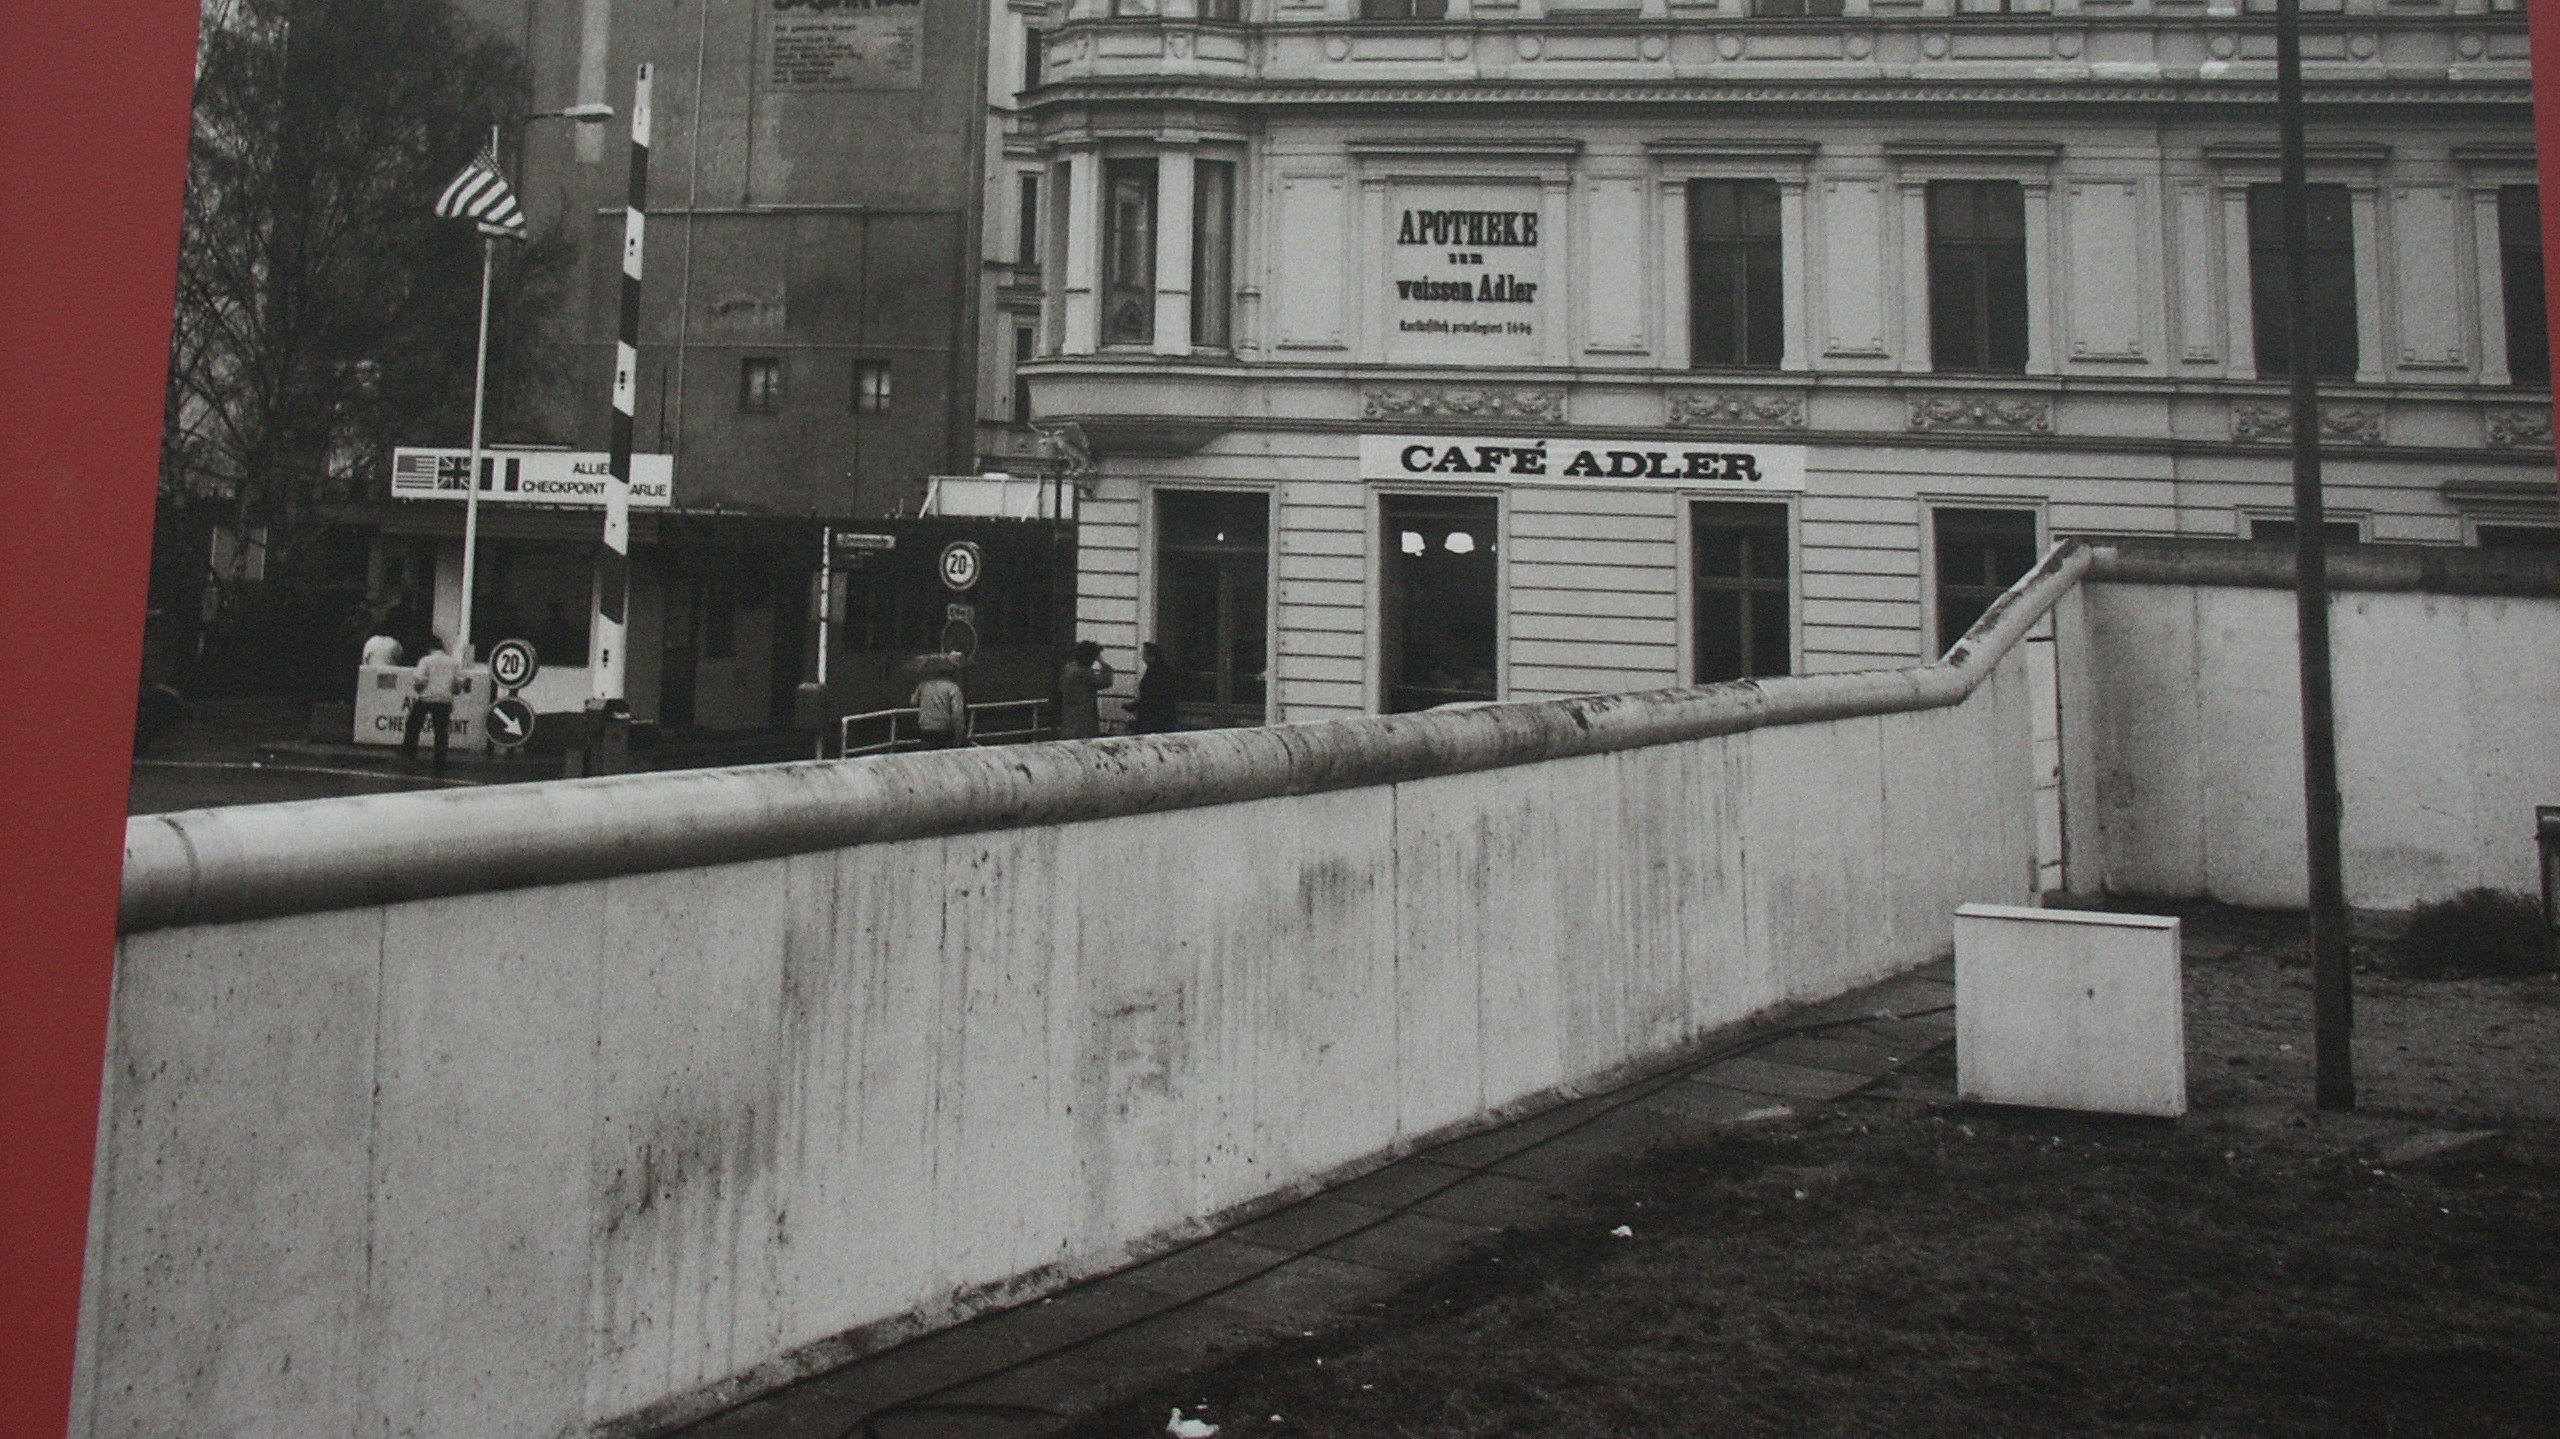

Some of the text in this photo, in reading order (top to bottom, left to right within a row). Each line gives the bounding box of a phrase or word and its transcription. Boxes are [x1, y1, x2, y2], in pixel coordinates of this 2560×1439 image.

[1397, 209, 1539, 247] APOTHEKE
[1396, 273, 1538, 303] weissen Adler
[573, 462, 609, 475] ALLIE
[1400, 440, 1762, 482] CAFÉ ADLER
[522, 480, 606, 495] CHECKPOINT
[949, 554, 967, 575] 20
[501, 653, 519, 674] 20
